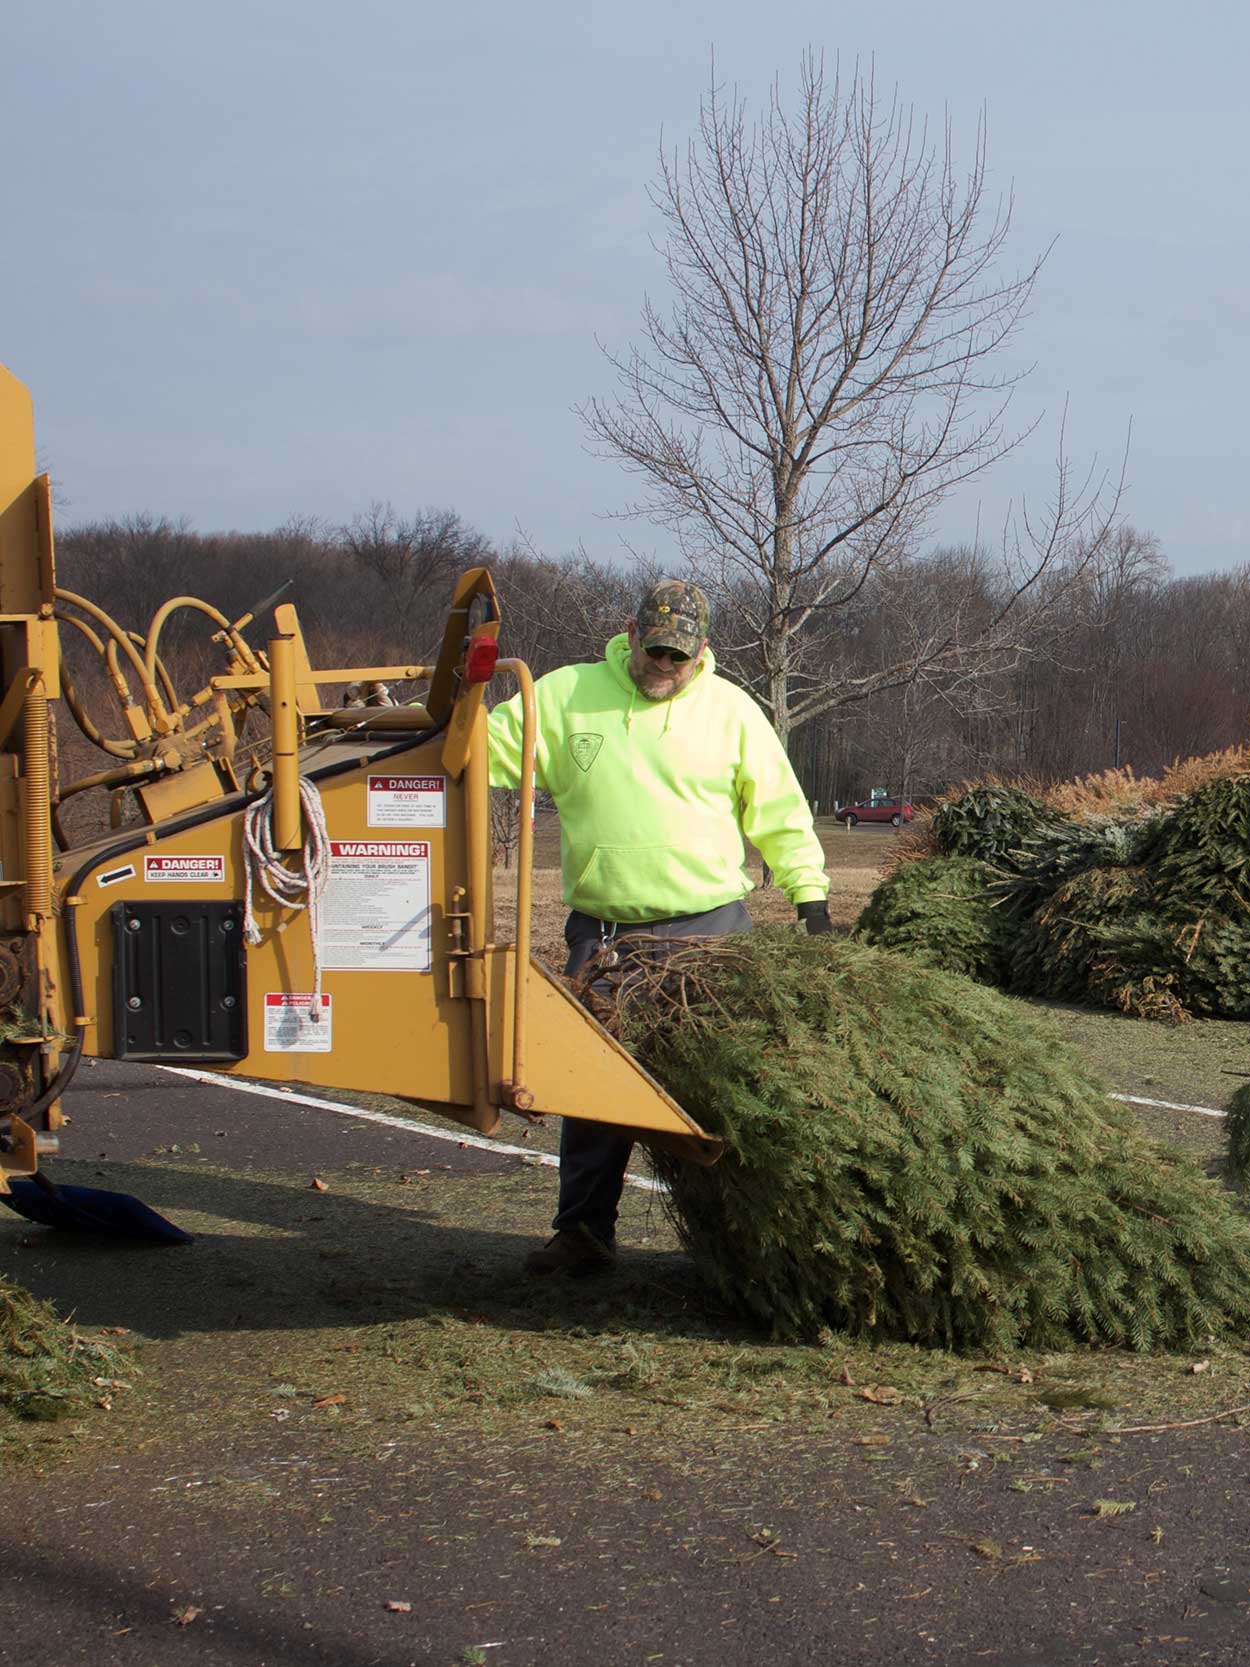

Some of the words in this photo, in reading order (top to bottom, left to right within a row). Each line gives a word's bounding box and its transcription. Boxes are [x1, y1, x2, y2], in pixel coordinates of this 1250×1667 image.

[389, 780, 440, 789] DANGER!
[393, 793, 419, 801] NEVER
[338, 844, 425, 856] WARNING!
[162, 860, 219, 869] DANGER!
